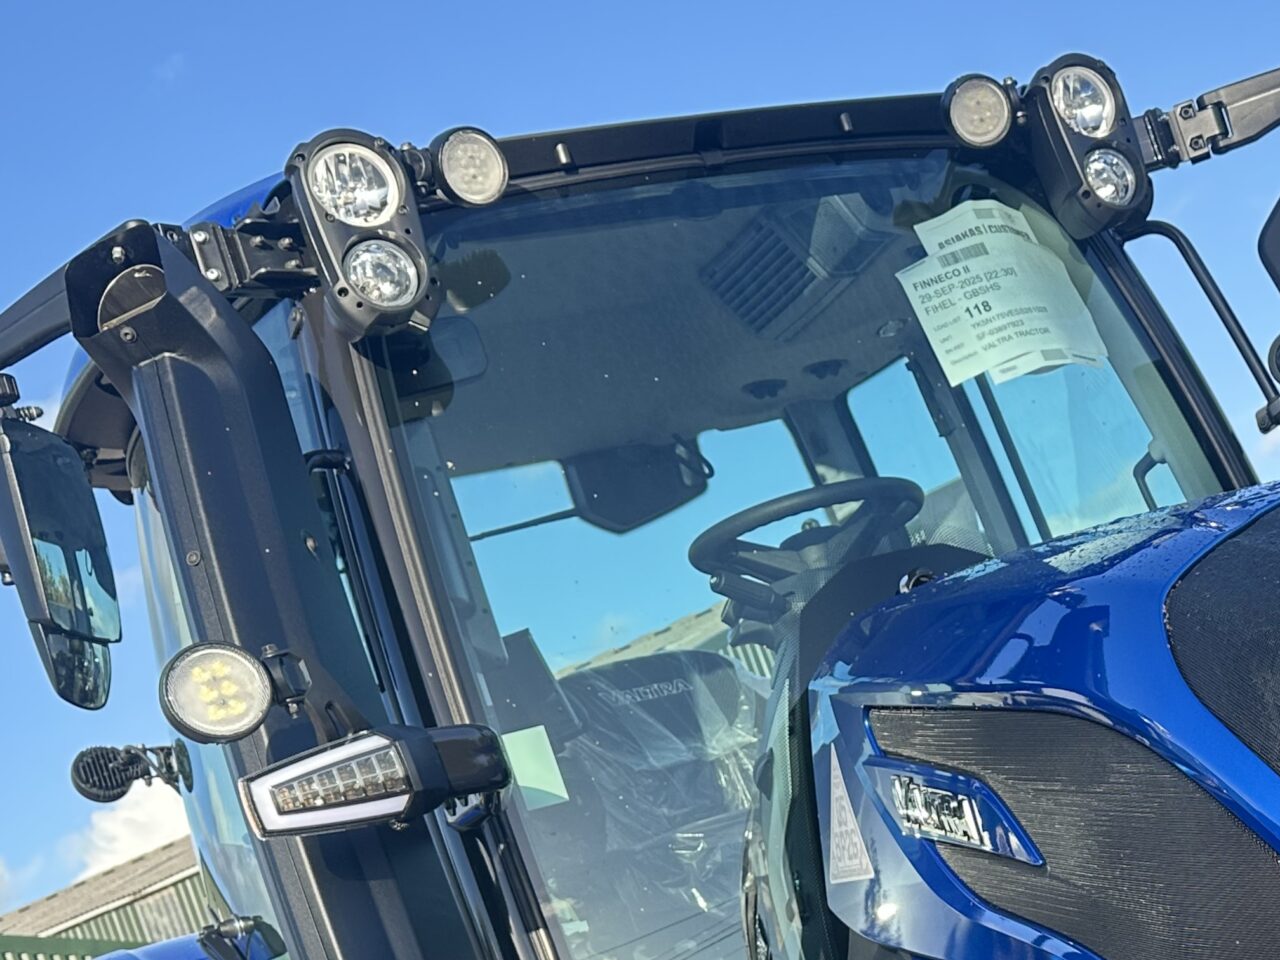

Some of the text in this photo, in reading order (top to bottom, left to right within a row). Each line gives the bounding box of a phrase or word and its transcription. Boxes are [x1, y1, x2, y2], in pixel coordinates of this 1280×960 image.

[912, 268, 962, 291] FINNECO
[918, 275, 984, 304] 29-SEP-2025
[924, 297, 957, 316] FIHEL
[963, 282, 1001, 300] GBSHS
[964, 300, 992, 319] 118
[981, 334, 1014, 351] VALTRA
[1013, 327, 1051, 339] TRACTOR
